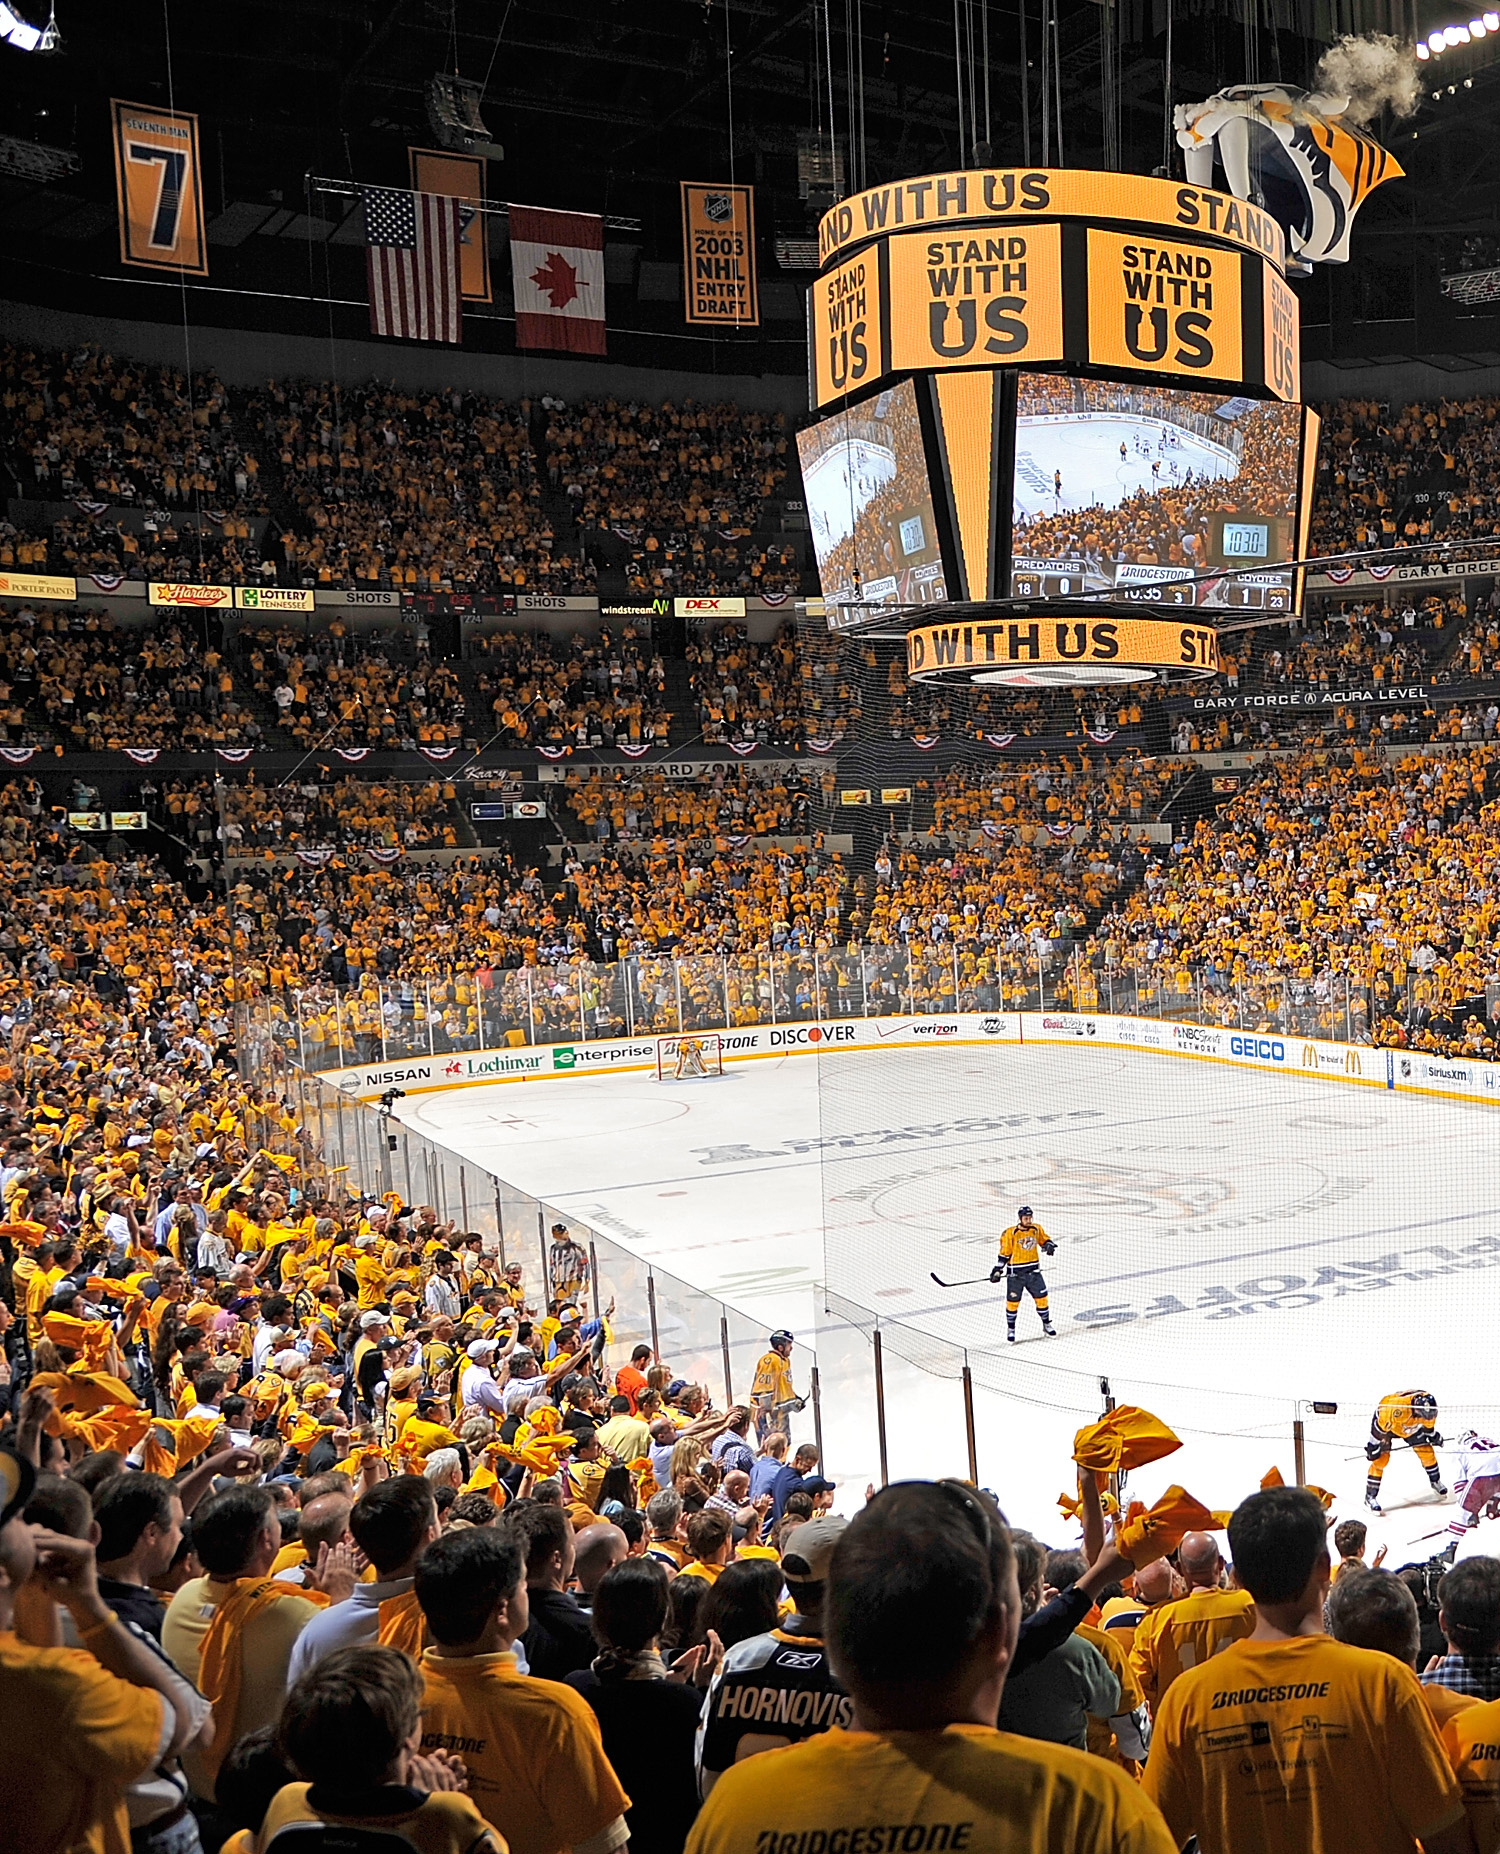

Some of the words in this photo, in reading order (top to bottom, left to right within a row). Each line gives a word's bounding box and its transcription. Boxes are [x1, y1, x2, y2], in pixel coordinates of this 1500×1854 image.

[126, 118, 167, 135] SEVENTH
[168, 127, 189, 139] MAN
[126, 140, 190, 251] 7
[861, 177, 967, 232] WITH
[983, 172, 1050, 212] US
[1176, 188, 1274, 253] STAND
[695, 236, 744, 257] 2003
[927, 237, 1026, 265] STAND
[696, 257, 745, 281] NHL
[1122, 245, 1212, 279] STAND
[697, 282, 746, 298] ENTRY
[828, 264, 865, 304] STAND
[927, 263, 1027, 297] WITH
[1123, 270, 1212, 311] WITH
[1271, 278, 1293, 319] STAND
[698, 299, 746, 315] DRAFT
[829, 287, 866, 333] WITH
[929, 296, 1029, 358] US
[1271, 301, 1293, 348] WITH
[1125, 302, 1213, 369] US
[830, 321, 867, 389] US
[1272, 331, 1293, 400] US
[787, 501, 803, 510] 333
[1014, 559, 1080, 572] PREDATORS
[1120, 566, 1191, 581] BRIDGESTONE
[1398, 564, 1439, 579] GARY
[1446, 560, 1499, 575] FORCE
[1059, 578, 1070, 595] 0
[1237, 573, 1282, 584] COYOTES
[12, 583, 46, 594] PORTER
[47, 586, 75, 596] PAINTS
[171, 585, 224, 599] Hardee's
[260, 589, 306, 600] LOTTERY
[346, 592, 392, 604] SHOTS
[1017, 583, 1032, 595] 18
[1174, 592, 1183, 604] 3
[1242, 588, 1249, 604] 1
[260, 600, 306, 610] TENNESSEE
[524, 597, 567, 608] SHOTS
[685, 600, 720, 609] DEX
[1270, 596, 1284, 608] 23
[932, 623, 1040, 665] WITH
[1055, 622, 1118, 659] US
[1194, 697, 1237, 709] GARY
[1244, 694, 1300, 706] FORCE
[1321, 691, 1373, 703] ACURA
[1378, 687, 1429, 700] LEVEL
[771, 1026, 856, 1046] DISCOVER
[913, 1024, 958, 1035] verizon
[558, 1046, 653, 1064] enterprise
[1177, 1041, 1217, 1053] NETWORK
[1230, 1037, 1285, 1061] GEICO
[467, 1055, 542, 1075] Lochinvar
[366, 1067, 431, 1087] NISSAN
[790, 1108, 1106, 1154] PLAYOFFS
[1210, 1681, 1331, 1710] BRIDGESTONE
[1206, 1731, 1249, 1746] Thompson
[755, 1820, 975, 1854] BRIDGESTONE
